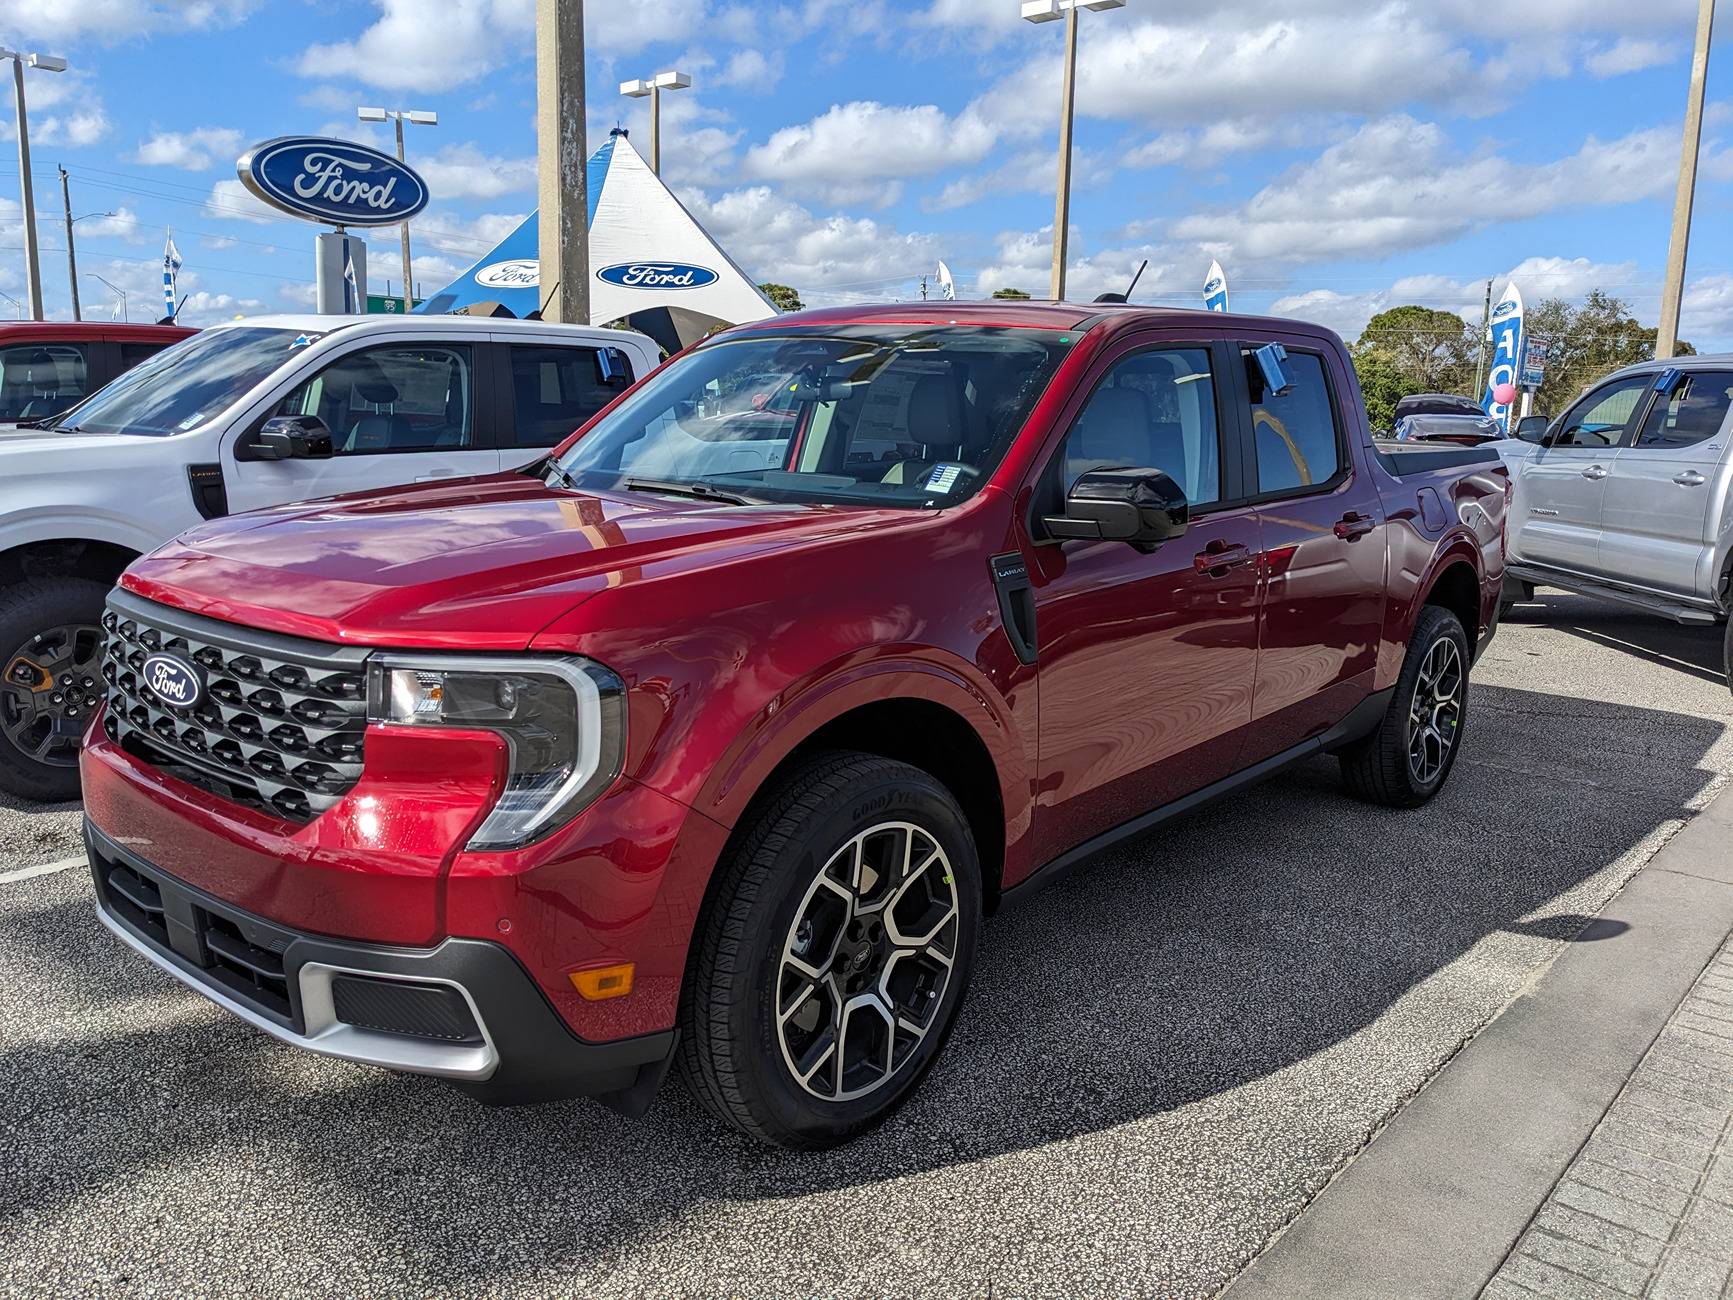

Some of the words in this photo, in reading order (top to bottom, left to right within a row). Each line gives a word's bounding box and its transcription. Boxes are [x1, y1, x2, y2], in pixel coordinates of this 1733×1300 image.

[294, 153, 397, 209] Ford
[622, 265, 695, 285] Ford
[153, 662, 187, 700] Ford
